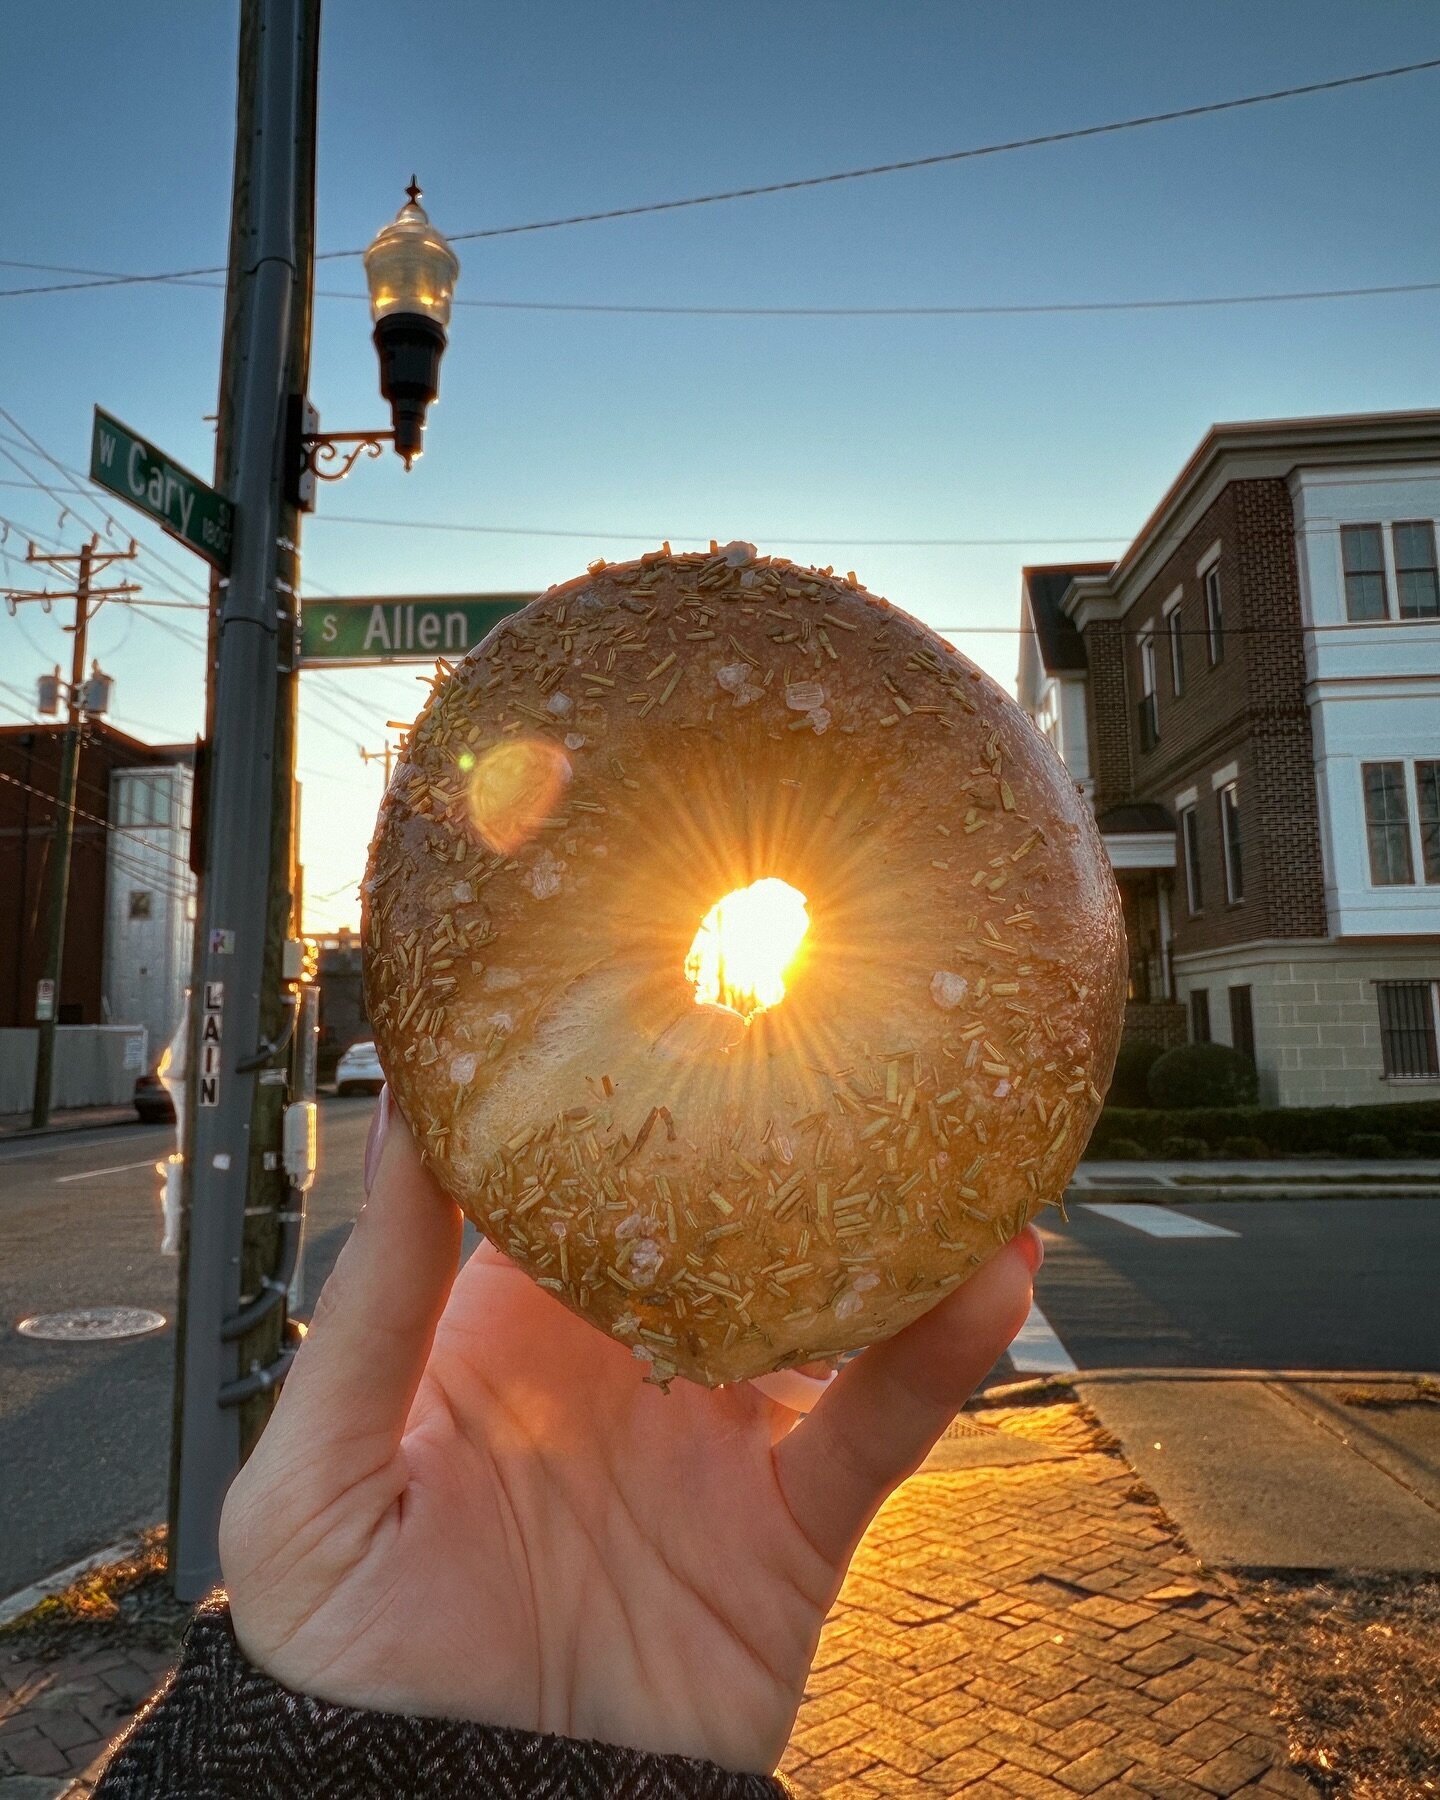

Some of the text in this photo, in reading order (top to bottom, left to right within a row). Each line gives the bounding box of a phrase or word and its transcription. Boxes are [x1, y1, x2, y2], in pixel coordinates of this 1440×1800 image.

[100, 428, 116, 468] W
[127, 441, 195, 537] Cary
[321, 604, 468, 650] S Allen
